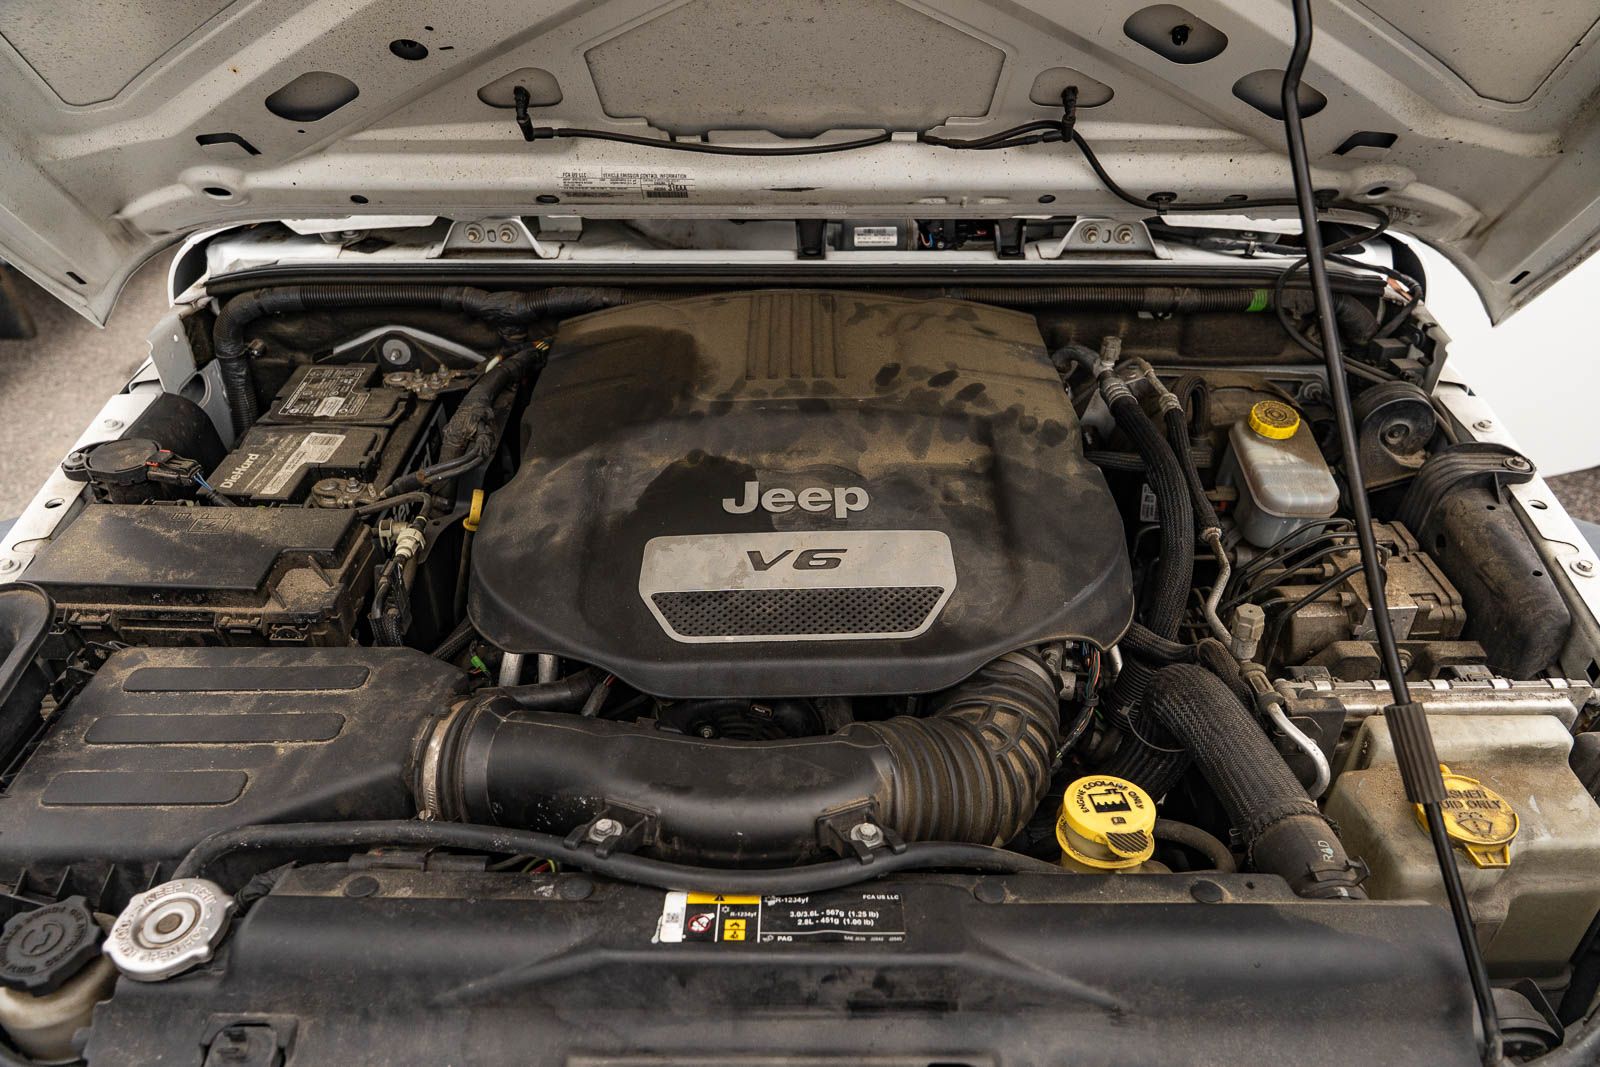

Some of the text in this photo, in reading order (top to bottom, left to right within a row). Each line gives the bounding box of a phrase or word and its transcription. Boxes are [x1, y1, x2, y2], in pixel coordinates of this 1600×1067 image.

[219, 453, 260, 489] DieHard
[722, 481, 870, 519] Jeep
[746, 548, 848, 571] V6
[1076, 780, 1145, 813] ENGINE COOLANT ONLY
[1446, 789, 1488, 799] SHER
[1466, 800, 1501, 809] ONLY
[143, 882, 185, 905] KEEP
[775, 896, 809, 904] R-1234yf
[797, 918, 814, 926] 2.8L
[820, 917, 840, 925] 451g
[843, 918, 862, 926] (1.00
[863, 918, 875, 927] lb)
[825, 909, 845, 918] 567g
[848, 910, 868, 918] (1.25
[868, 910, 880, 919] lb)
